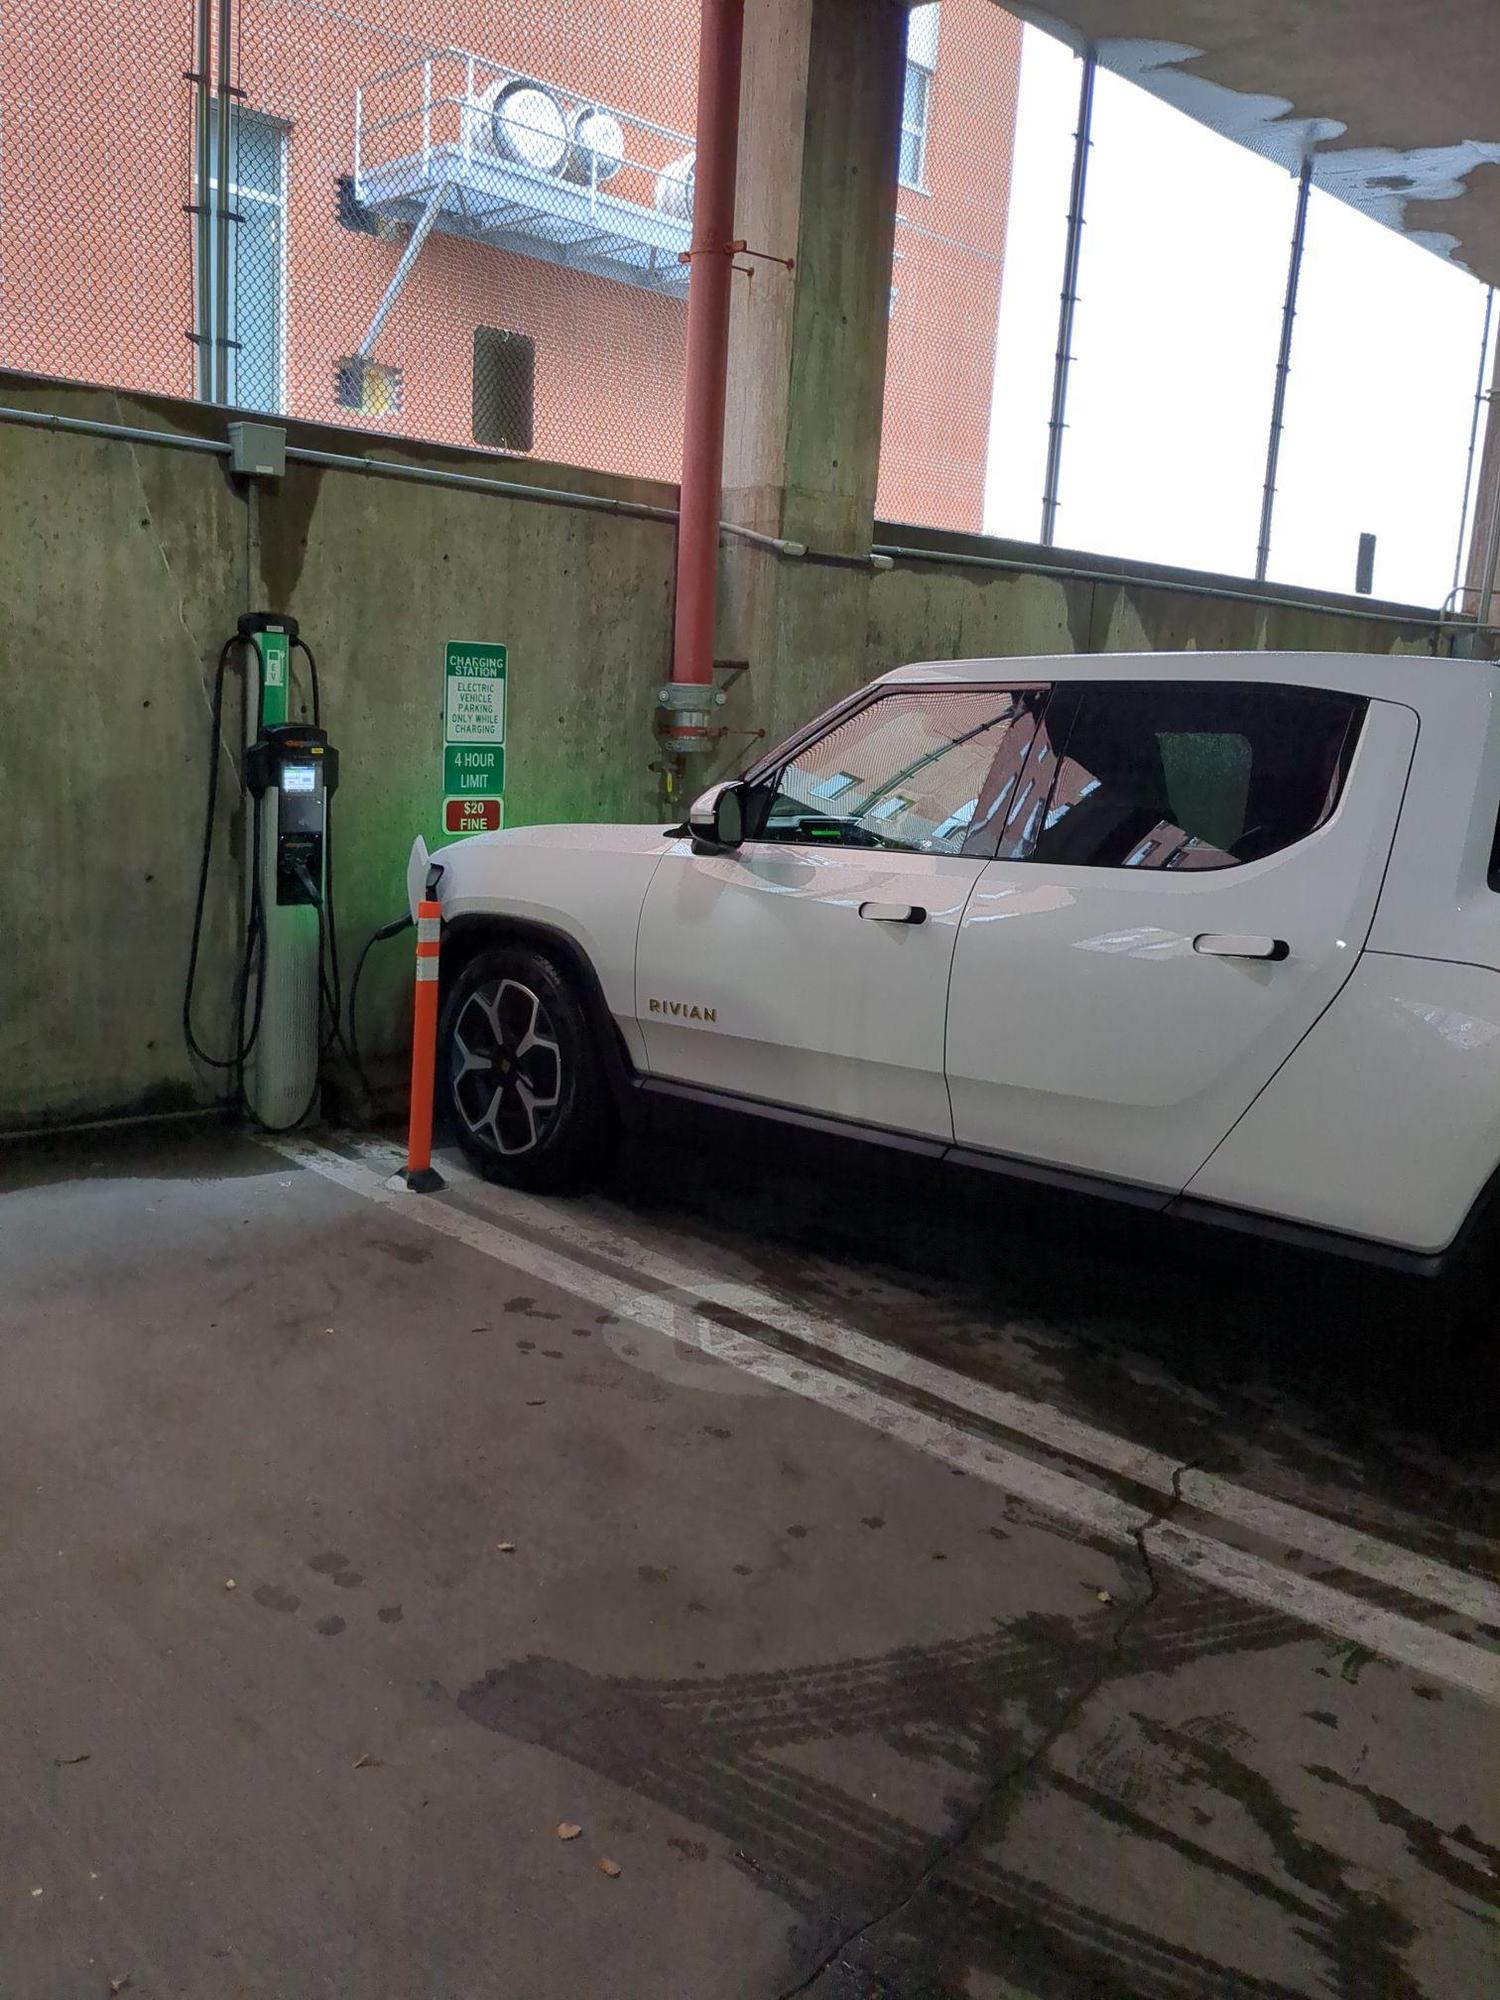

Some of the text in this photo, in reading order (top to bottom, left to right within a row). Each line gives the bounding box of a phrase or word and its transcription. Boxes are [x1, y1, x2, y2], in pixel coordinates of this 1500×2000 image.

[449, 655, 504, 669] CHARGING
[455, 666, 497, 677] STATION
[457, 682, 495, 693] ELECTRIC
[460, 693, 493, 704] VEHICLE
[458, 703, 493, 714] PARKING
[452, 714, 499, 724] ONLY WHILE
[455, 724, 496, 734] CHARGING
[454, 752, 495, 767] 4 HOUR
[461, 774, 489, 788] LIMIT
[464, 802, 485, 815] $20
[460, 818, 488, 830] FINE
[649, 998, 718, 1023] RIVIAN
